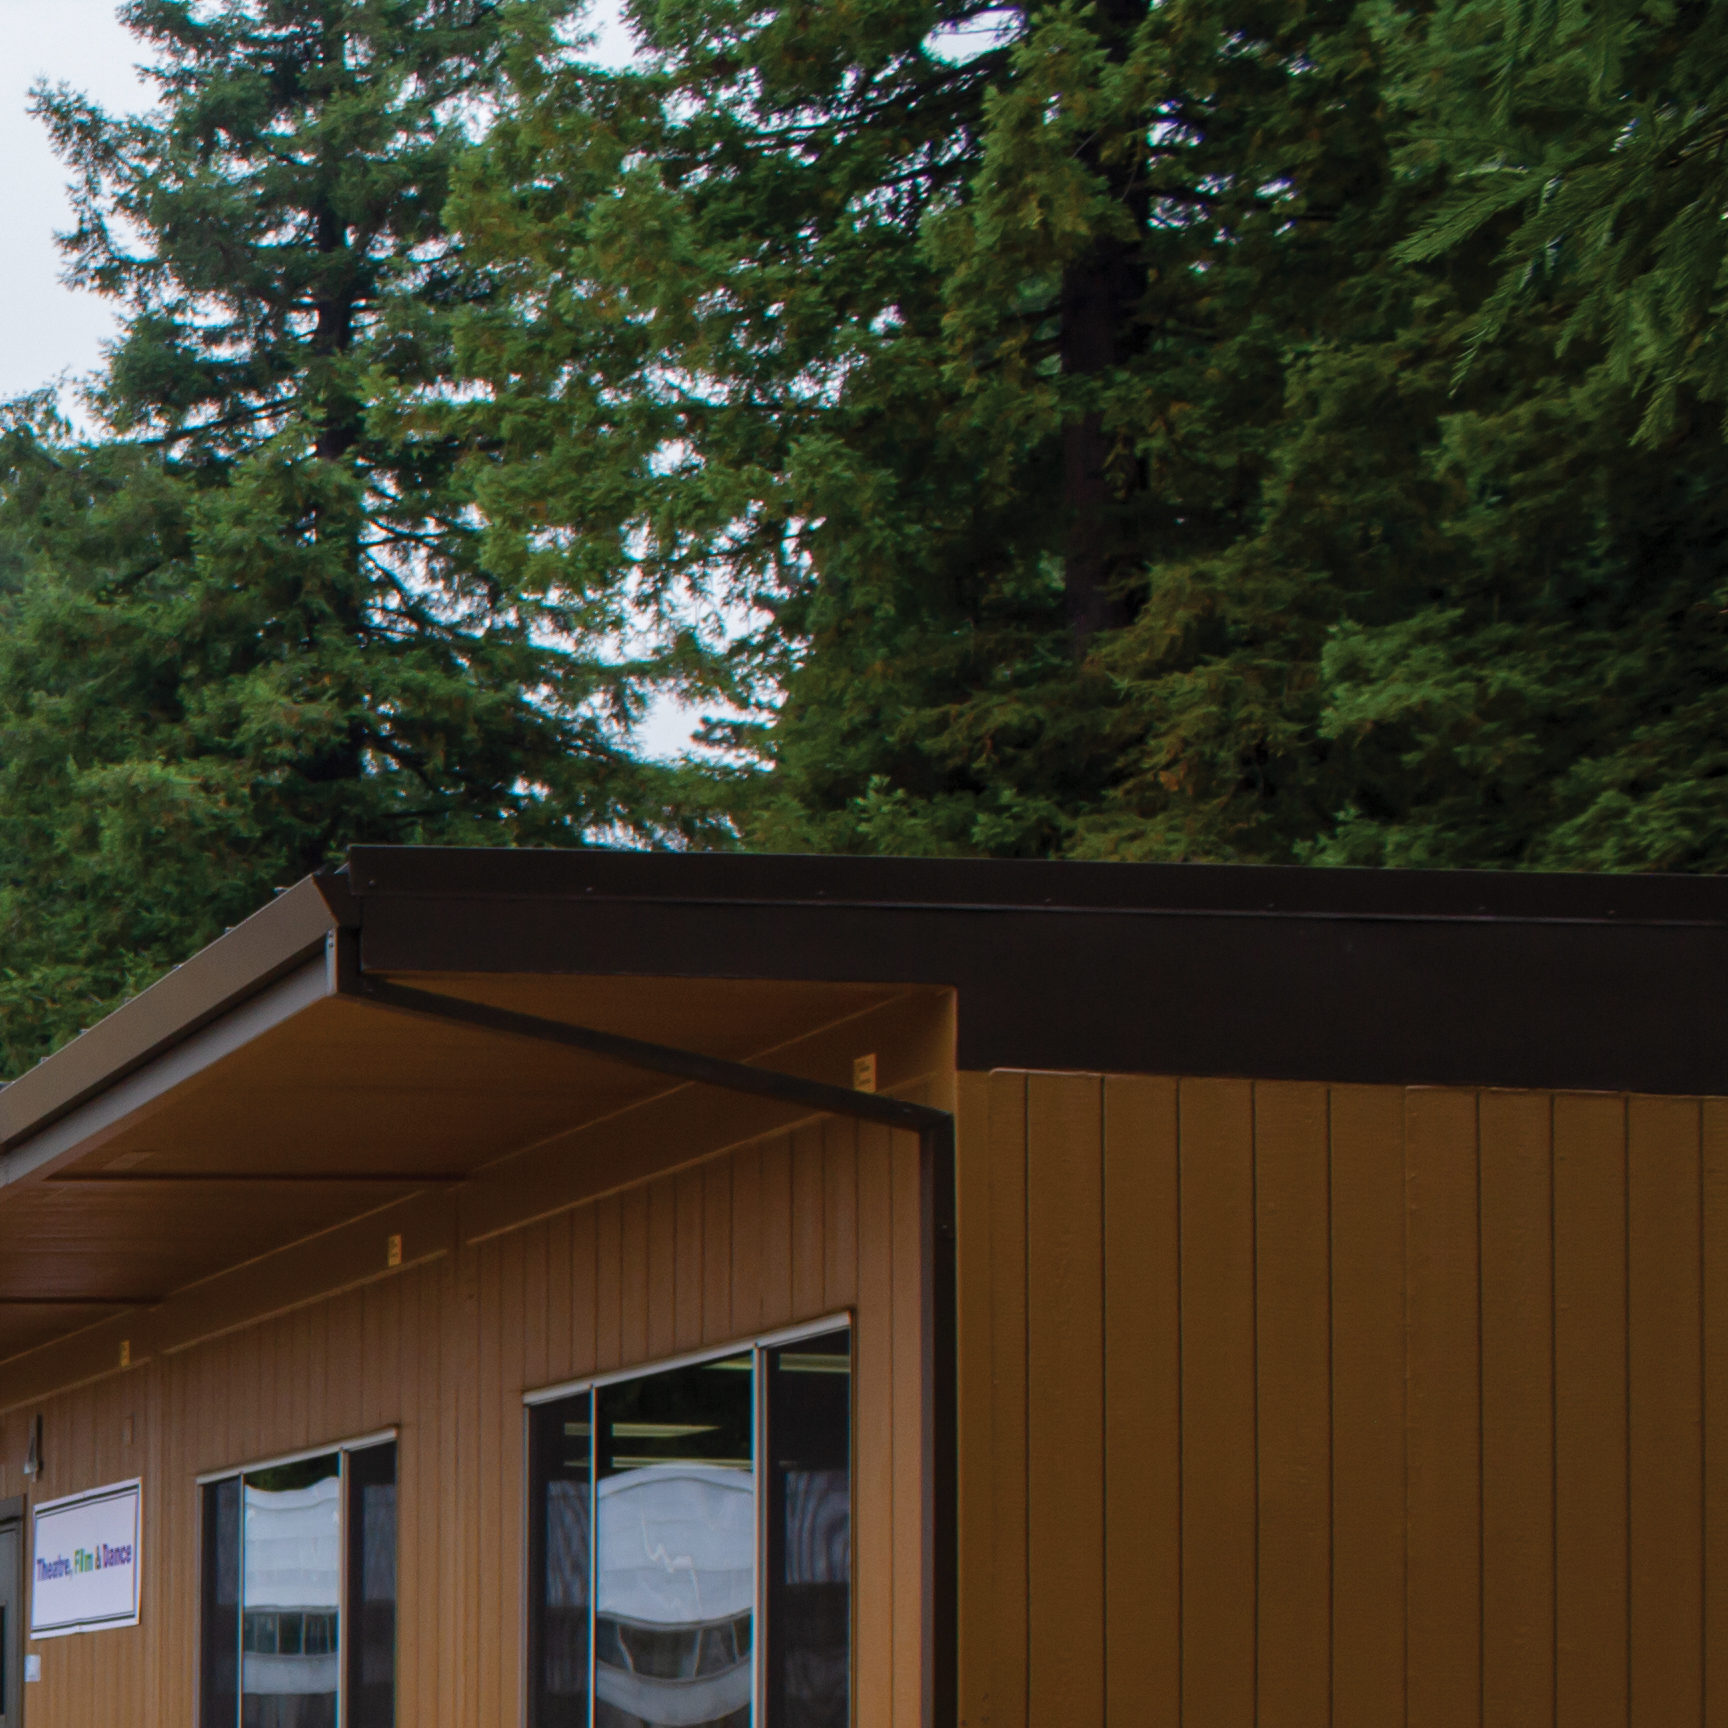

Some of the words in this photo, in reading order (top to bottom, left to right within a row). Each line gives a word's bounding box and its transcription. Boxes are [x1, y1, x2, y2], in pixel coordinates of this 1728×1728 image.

[37, 1554, 72, 1581] Theatre,
[74, 1548, 93, 1574] Film
[103, 1543, 131, 1569] Dance
